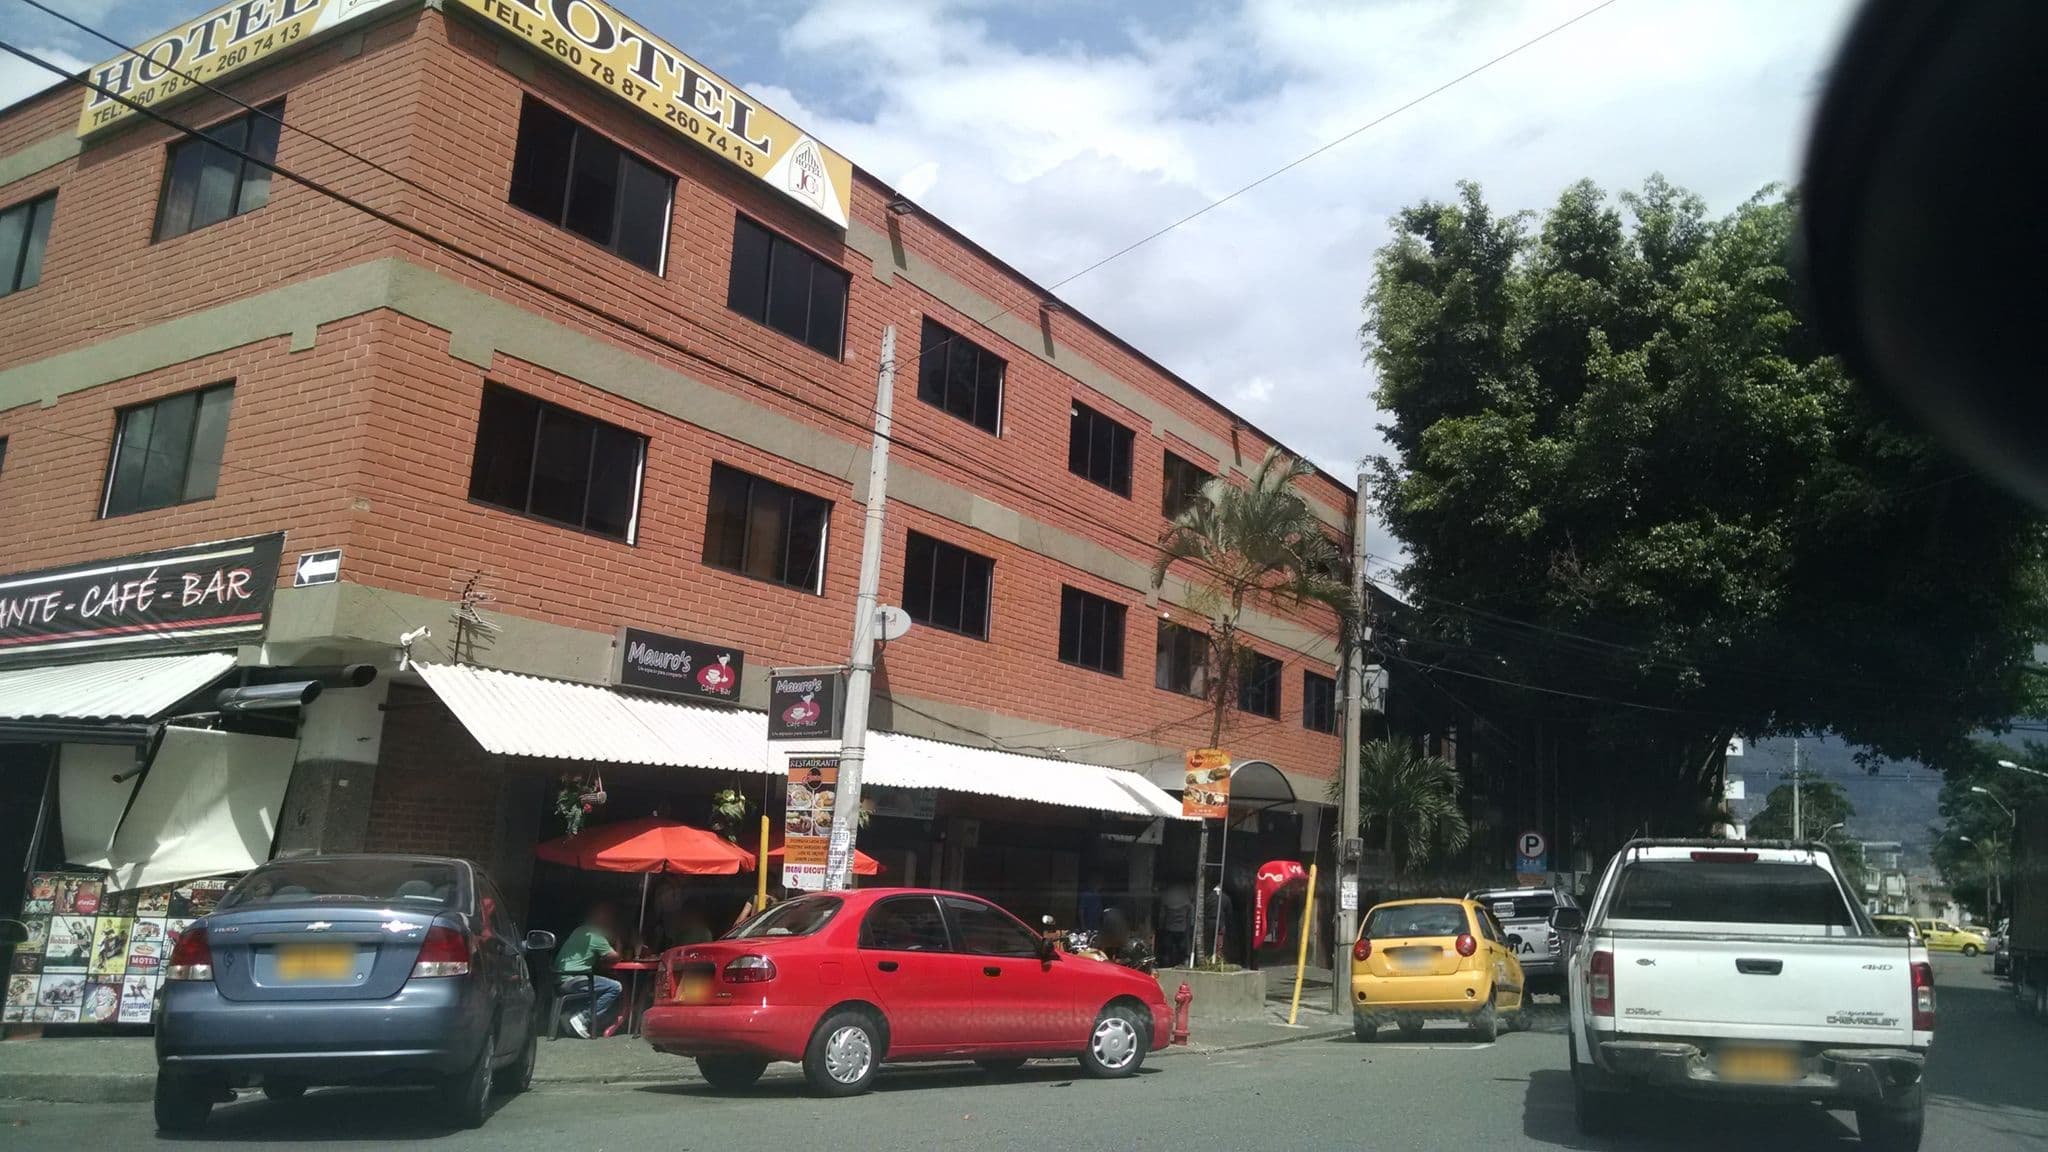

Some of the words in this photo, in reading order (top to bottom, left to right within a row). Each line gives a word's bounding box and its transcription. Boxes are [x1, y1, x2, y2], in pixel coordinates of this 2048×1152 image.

[93, 104, 123, 126] TEL:
[160, 77, 178, 97] 78
[182, 64, 204, 88] 87
[217, 45, 247, 70] 260
[254, 34, 273, 56] 74
[280, 22, 302, 43] 13
[540, 28, 582, 65] 260
[589, 57, 615, 85] 78
[621, 77, 647, 103] 87
[664, 102, 700, 135] 260
[706, 126, 728, 152] 74
[733, 144, 754, 168] 13
[627, 641, 692, 673] Mauro's
[775, 678, 823, 694] Mauro's
[1525, 835, 1540, 854] P
[1826, 1016, 1899, 1026] CHEVROLET
